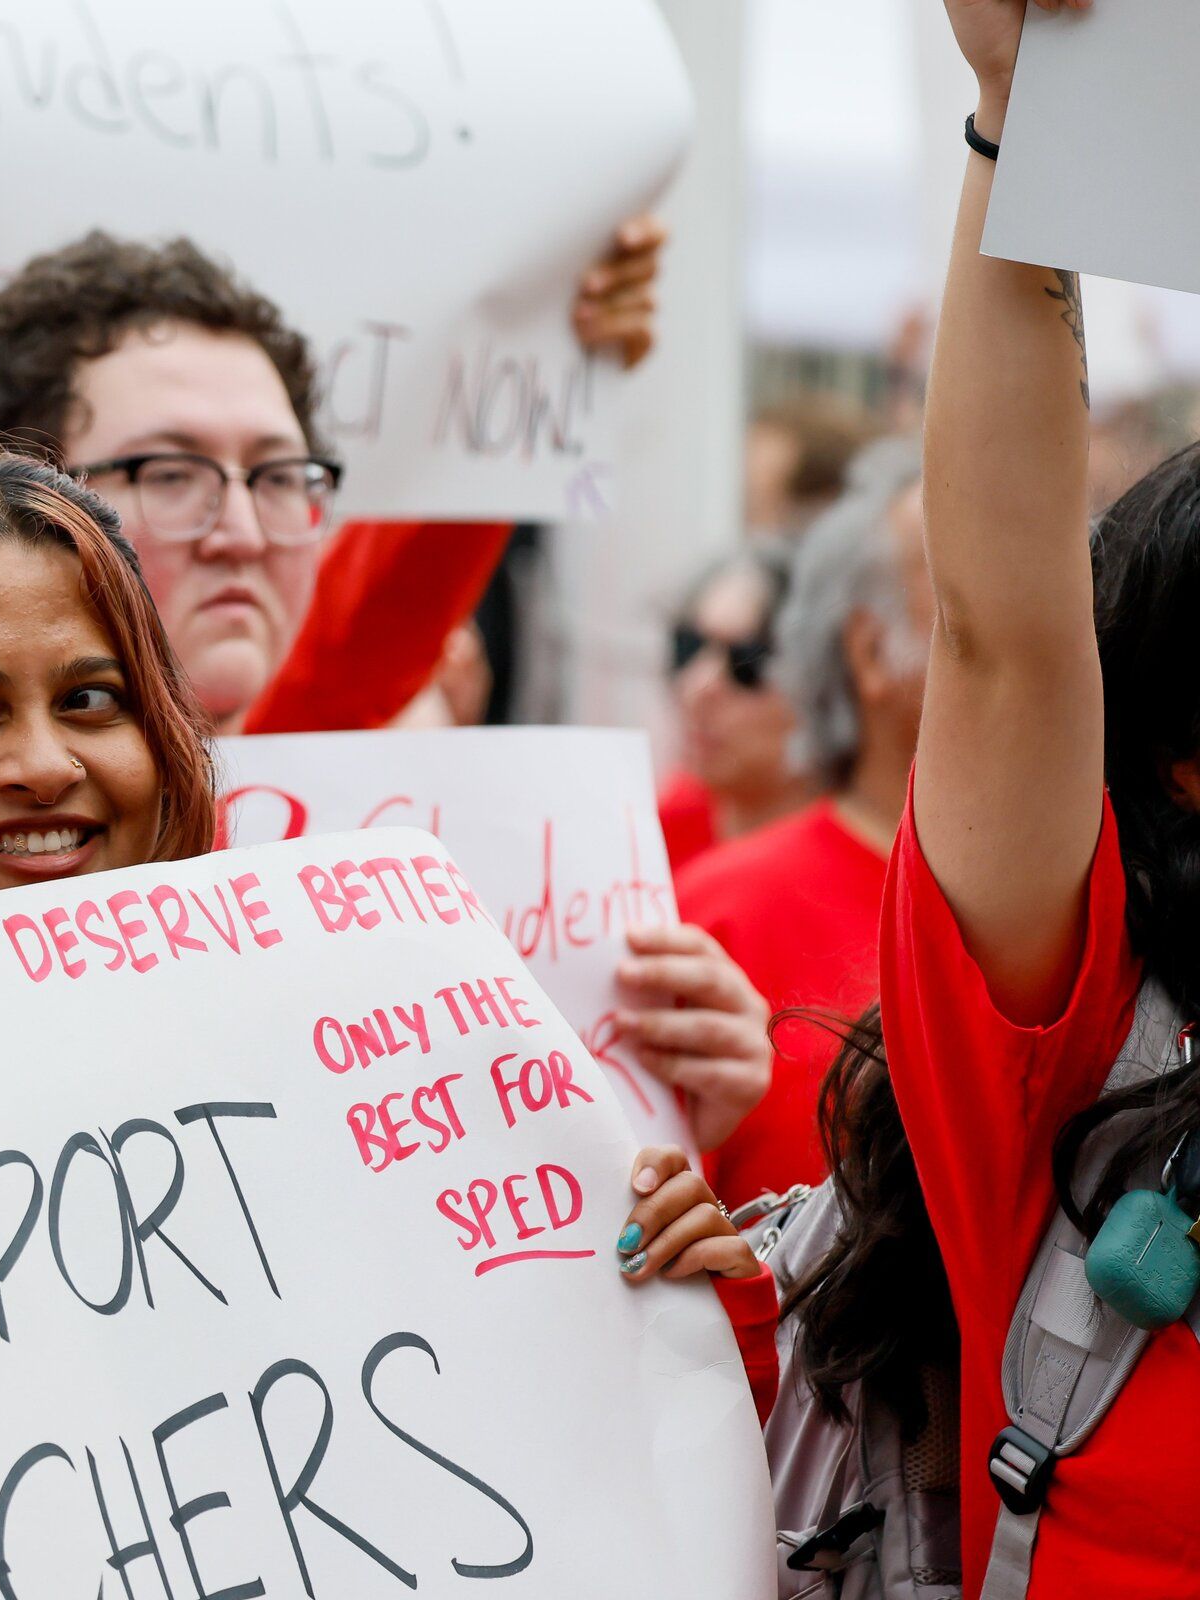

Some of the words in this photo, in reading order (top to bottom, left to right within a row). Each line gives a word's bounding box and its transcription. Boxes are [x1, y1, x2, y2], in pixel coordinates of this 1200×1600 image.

[2, 872, 284, 983] DESERVE
[297, 855, 498, 934] BETTER
[313, 1003, 432, 1075] ONLY
[434, 977, 542, 1036] THE
[346, 1073, 467, 1174] BEST
[490, 1050, 595, 1129] FOR
[435, 1163, 584, 1252] SPED
